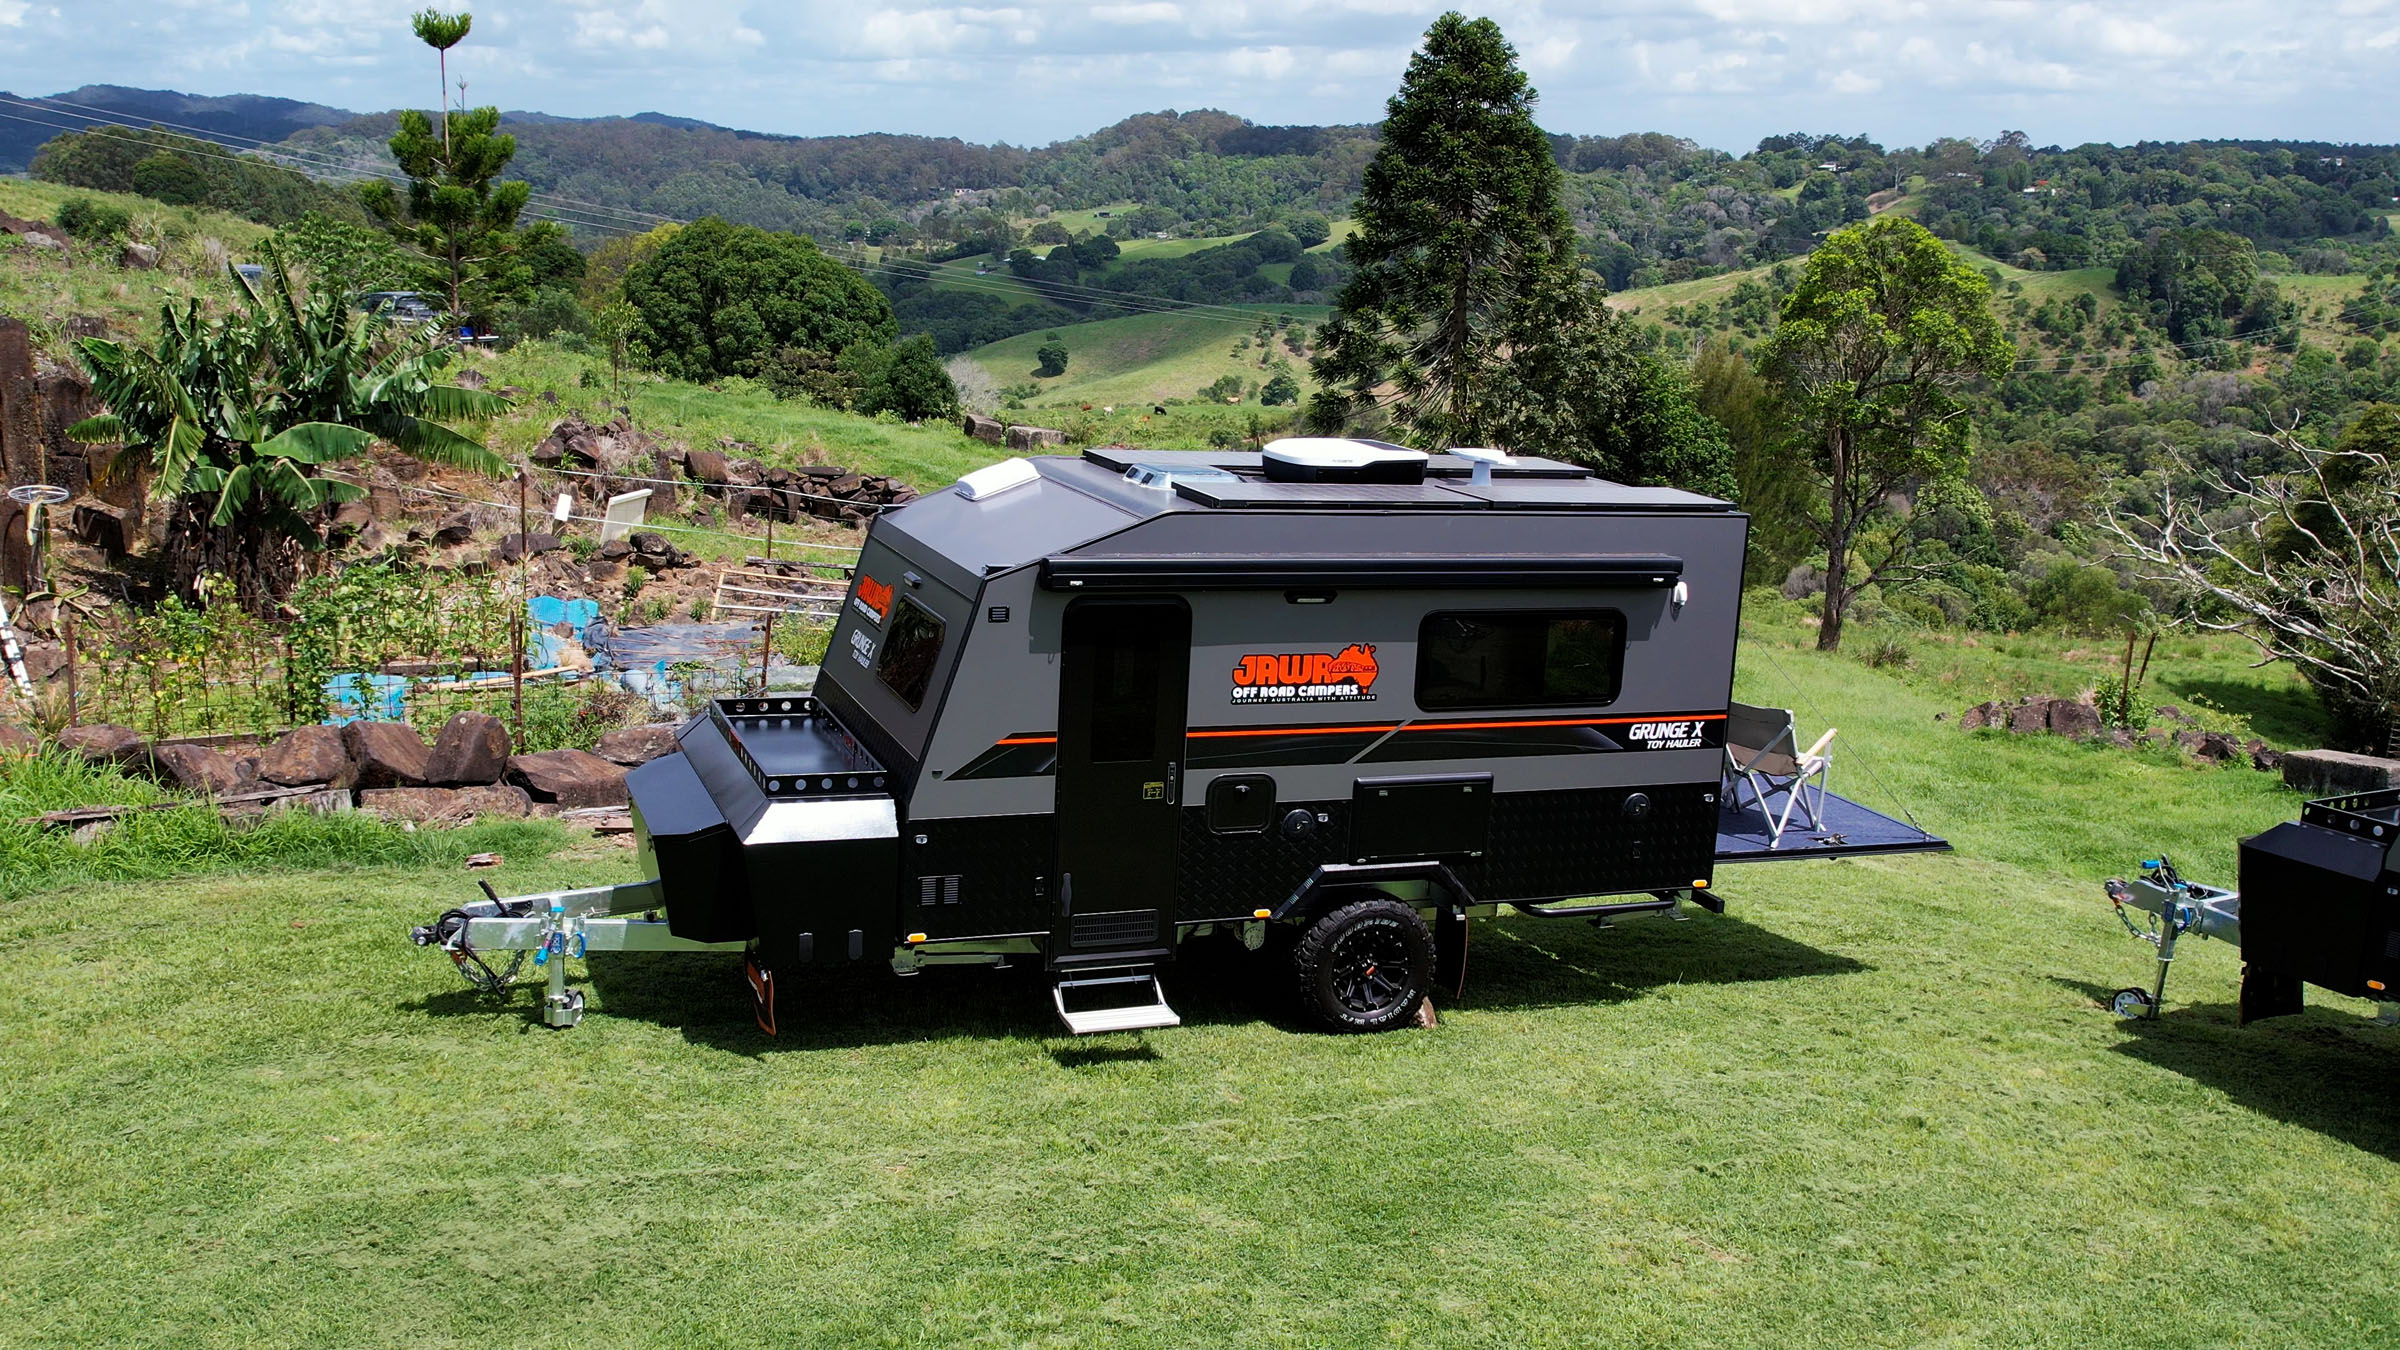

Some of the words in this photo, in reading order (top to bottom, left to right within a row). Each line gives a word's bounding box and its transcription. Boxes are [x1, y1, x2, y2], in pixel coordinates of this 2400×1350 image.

[1232, 686, 1258, 698] OFF
[1260, 686, 1295, 697] ROAD
[1298, 684, 1358, 696] CAMPERS
[1629, 722, 1690, 740] GRUNGE
[1691, 721, 1705, 737] X
[1647, 740, 1665, 749] TOY
[1665, 738, 1702, 748] HAULER
